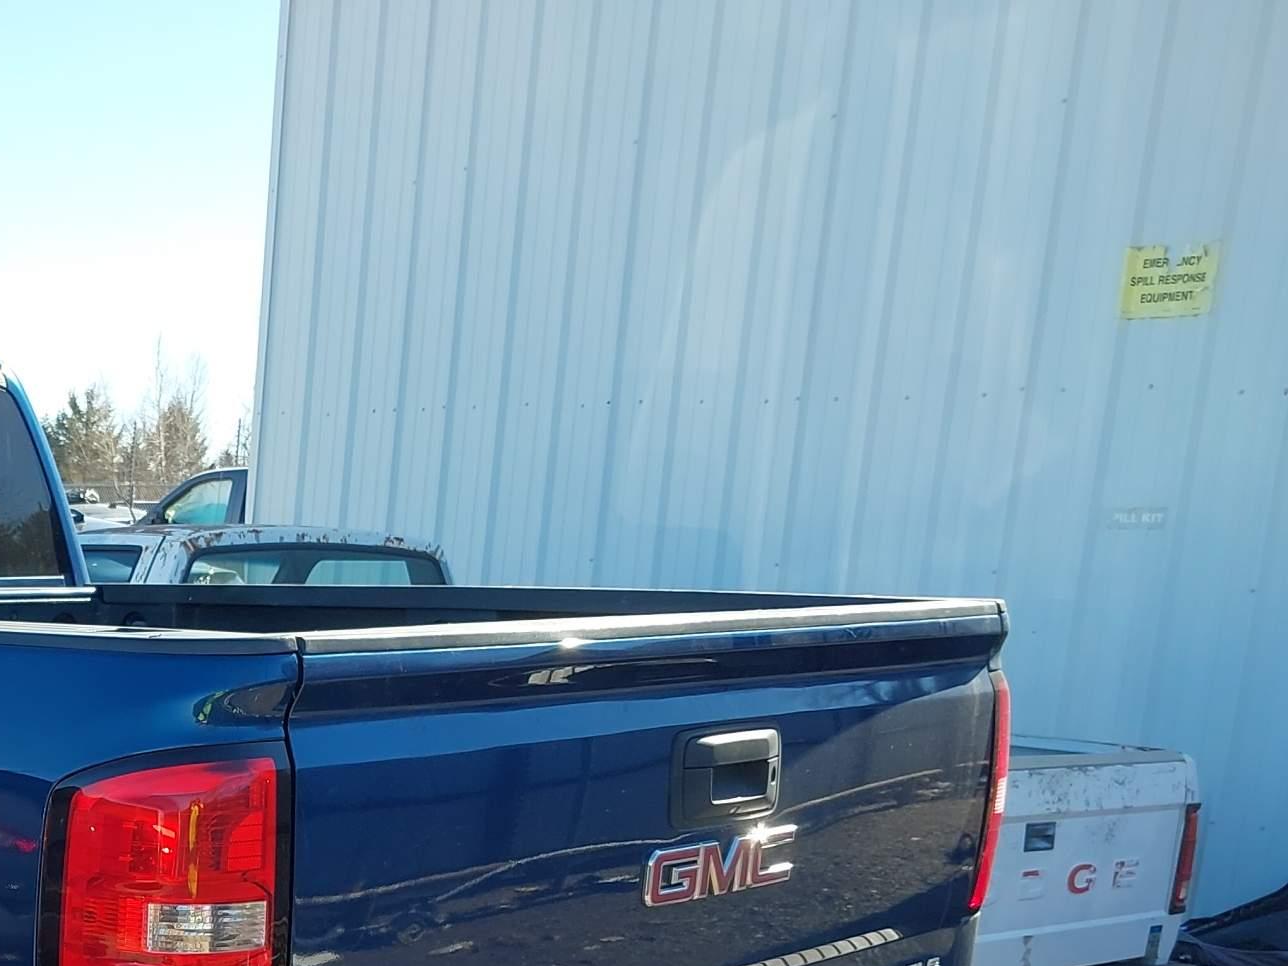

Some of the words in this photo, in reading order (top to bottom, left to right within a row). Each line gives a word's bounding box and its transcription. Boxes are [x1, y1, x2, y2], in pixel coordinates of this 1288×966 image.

[1142, 255, 1203, 270] EMERNCY
[1129, 275, 1155, 287] SPILL
[1157, 272, 1207, 286] RESPONSE
[1140, 290, 1194, 304] EQUIPMENT
[644, 824, 799, 908] GMC
